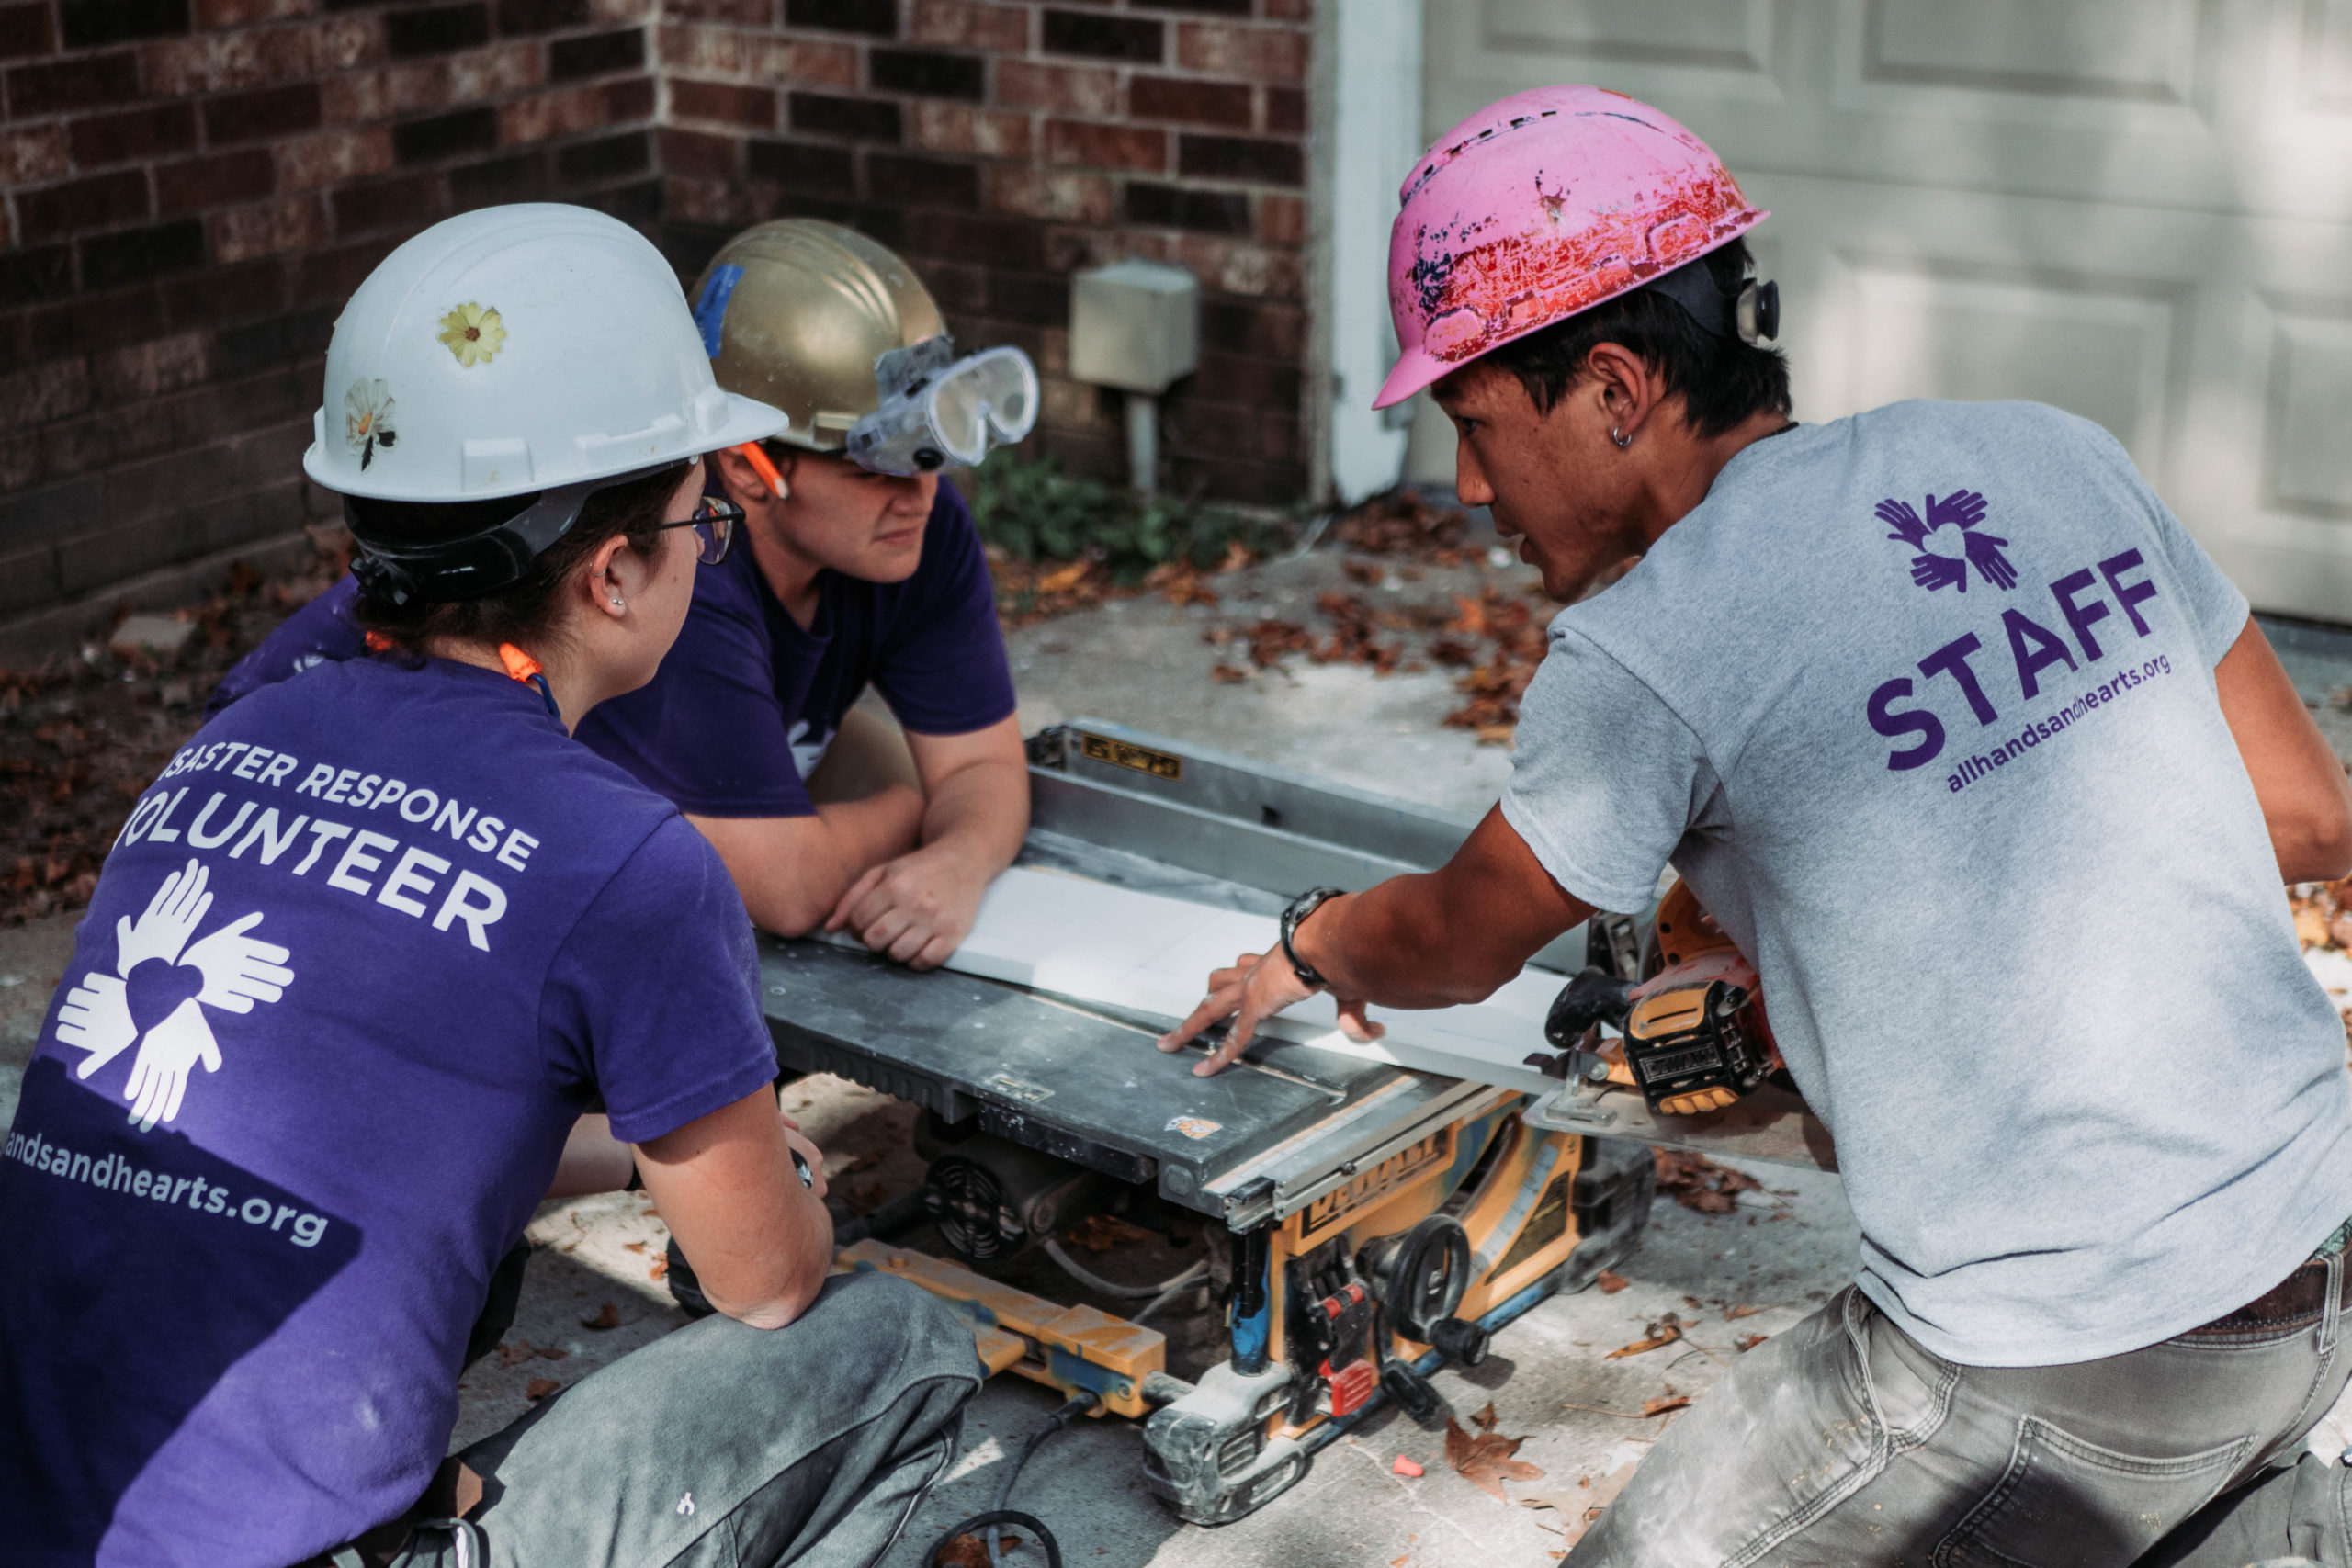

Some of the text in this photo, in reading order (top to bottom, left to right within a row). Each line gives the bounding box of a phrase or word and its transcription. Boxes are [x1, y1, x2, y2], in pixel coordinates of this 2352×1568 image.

[1866, 547, 2157, 772] STAFF
[1946, 651, 2173, 793] allhandsandhearts.org
[156, 741, 540, 873] ISASTER RESPONSE
[3, 1132, 329, 1248] andsandhearts.org
